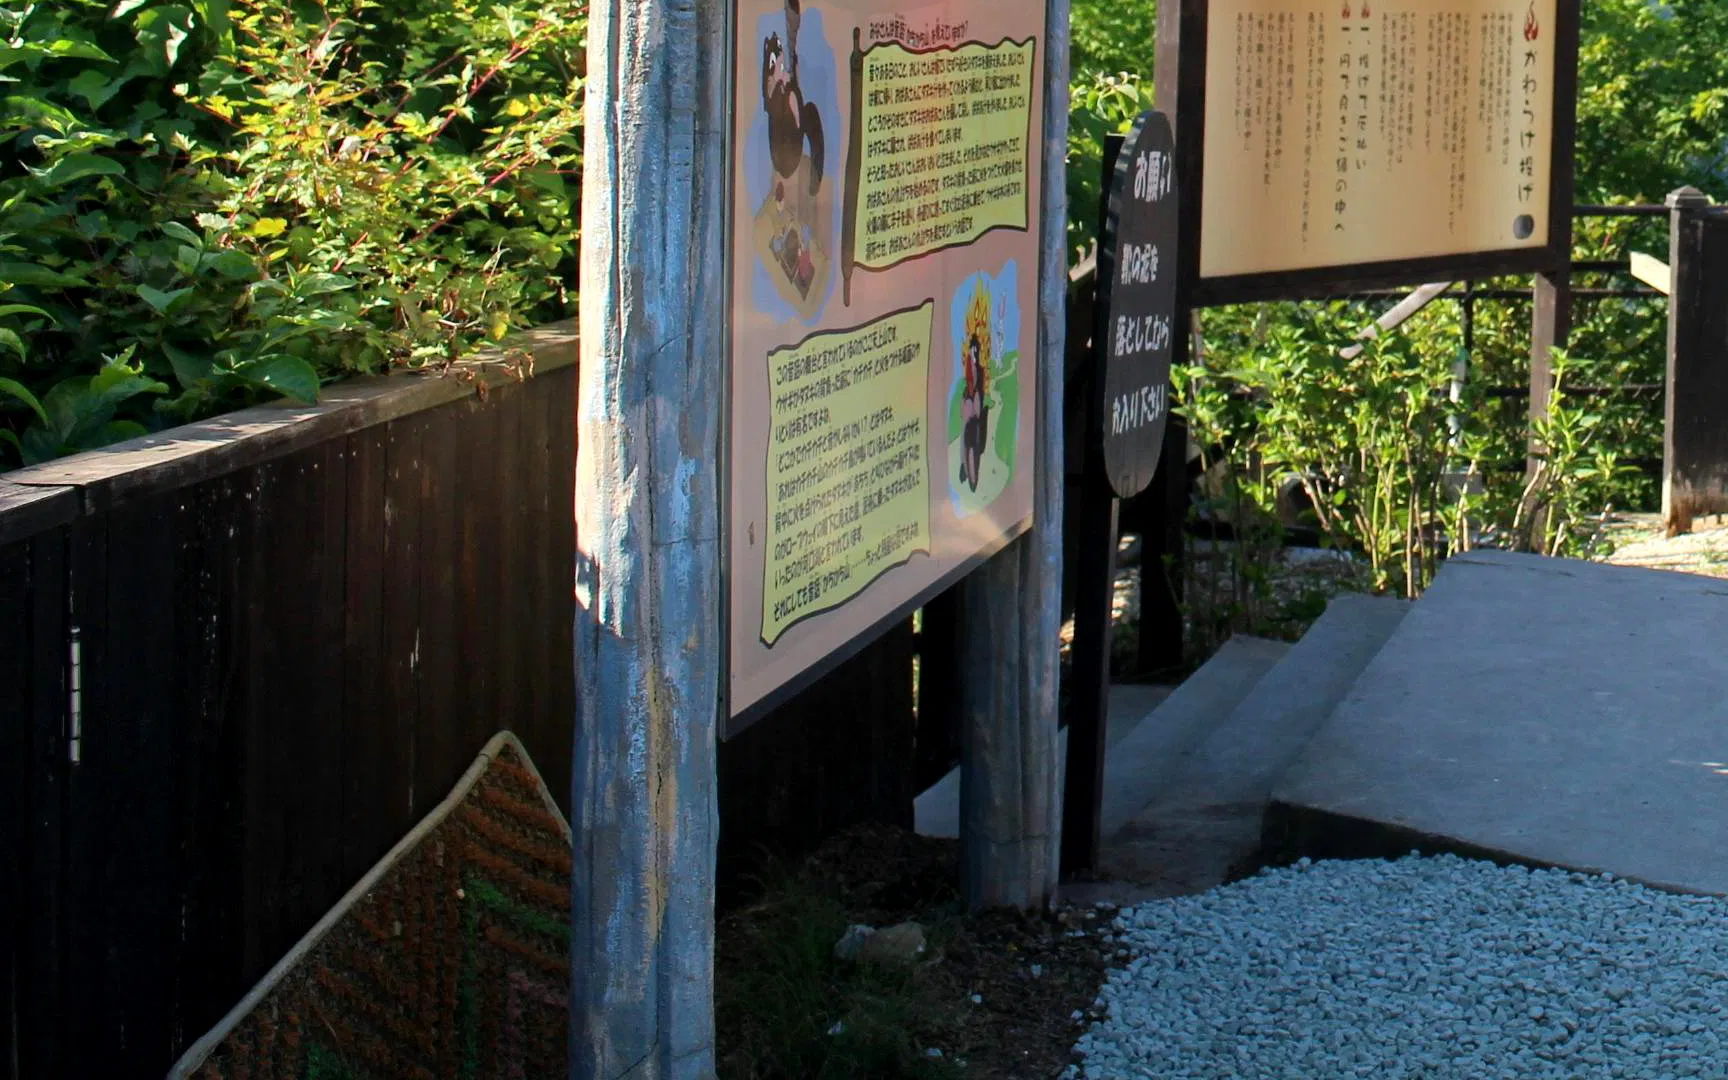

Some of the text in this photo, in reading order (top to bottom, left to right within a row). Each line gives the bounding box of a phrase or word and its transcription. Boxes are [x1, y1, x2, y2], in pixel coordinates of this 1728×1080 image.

[1517, 50, 1537, 203] かわらけ投げ
[1134, 150, 1172, 202] お願い
[1121, 243, 1158, 285] 靴の泥を
[1115, 315, 1169, 356] 落としてから
[1112, 383, 1165, 437] お入り下さい
